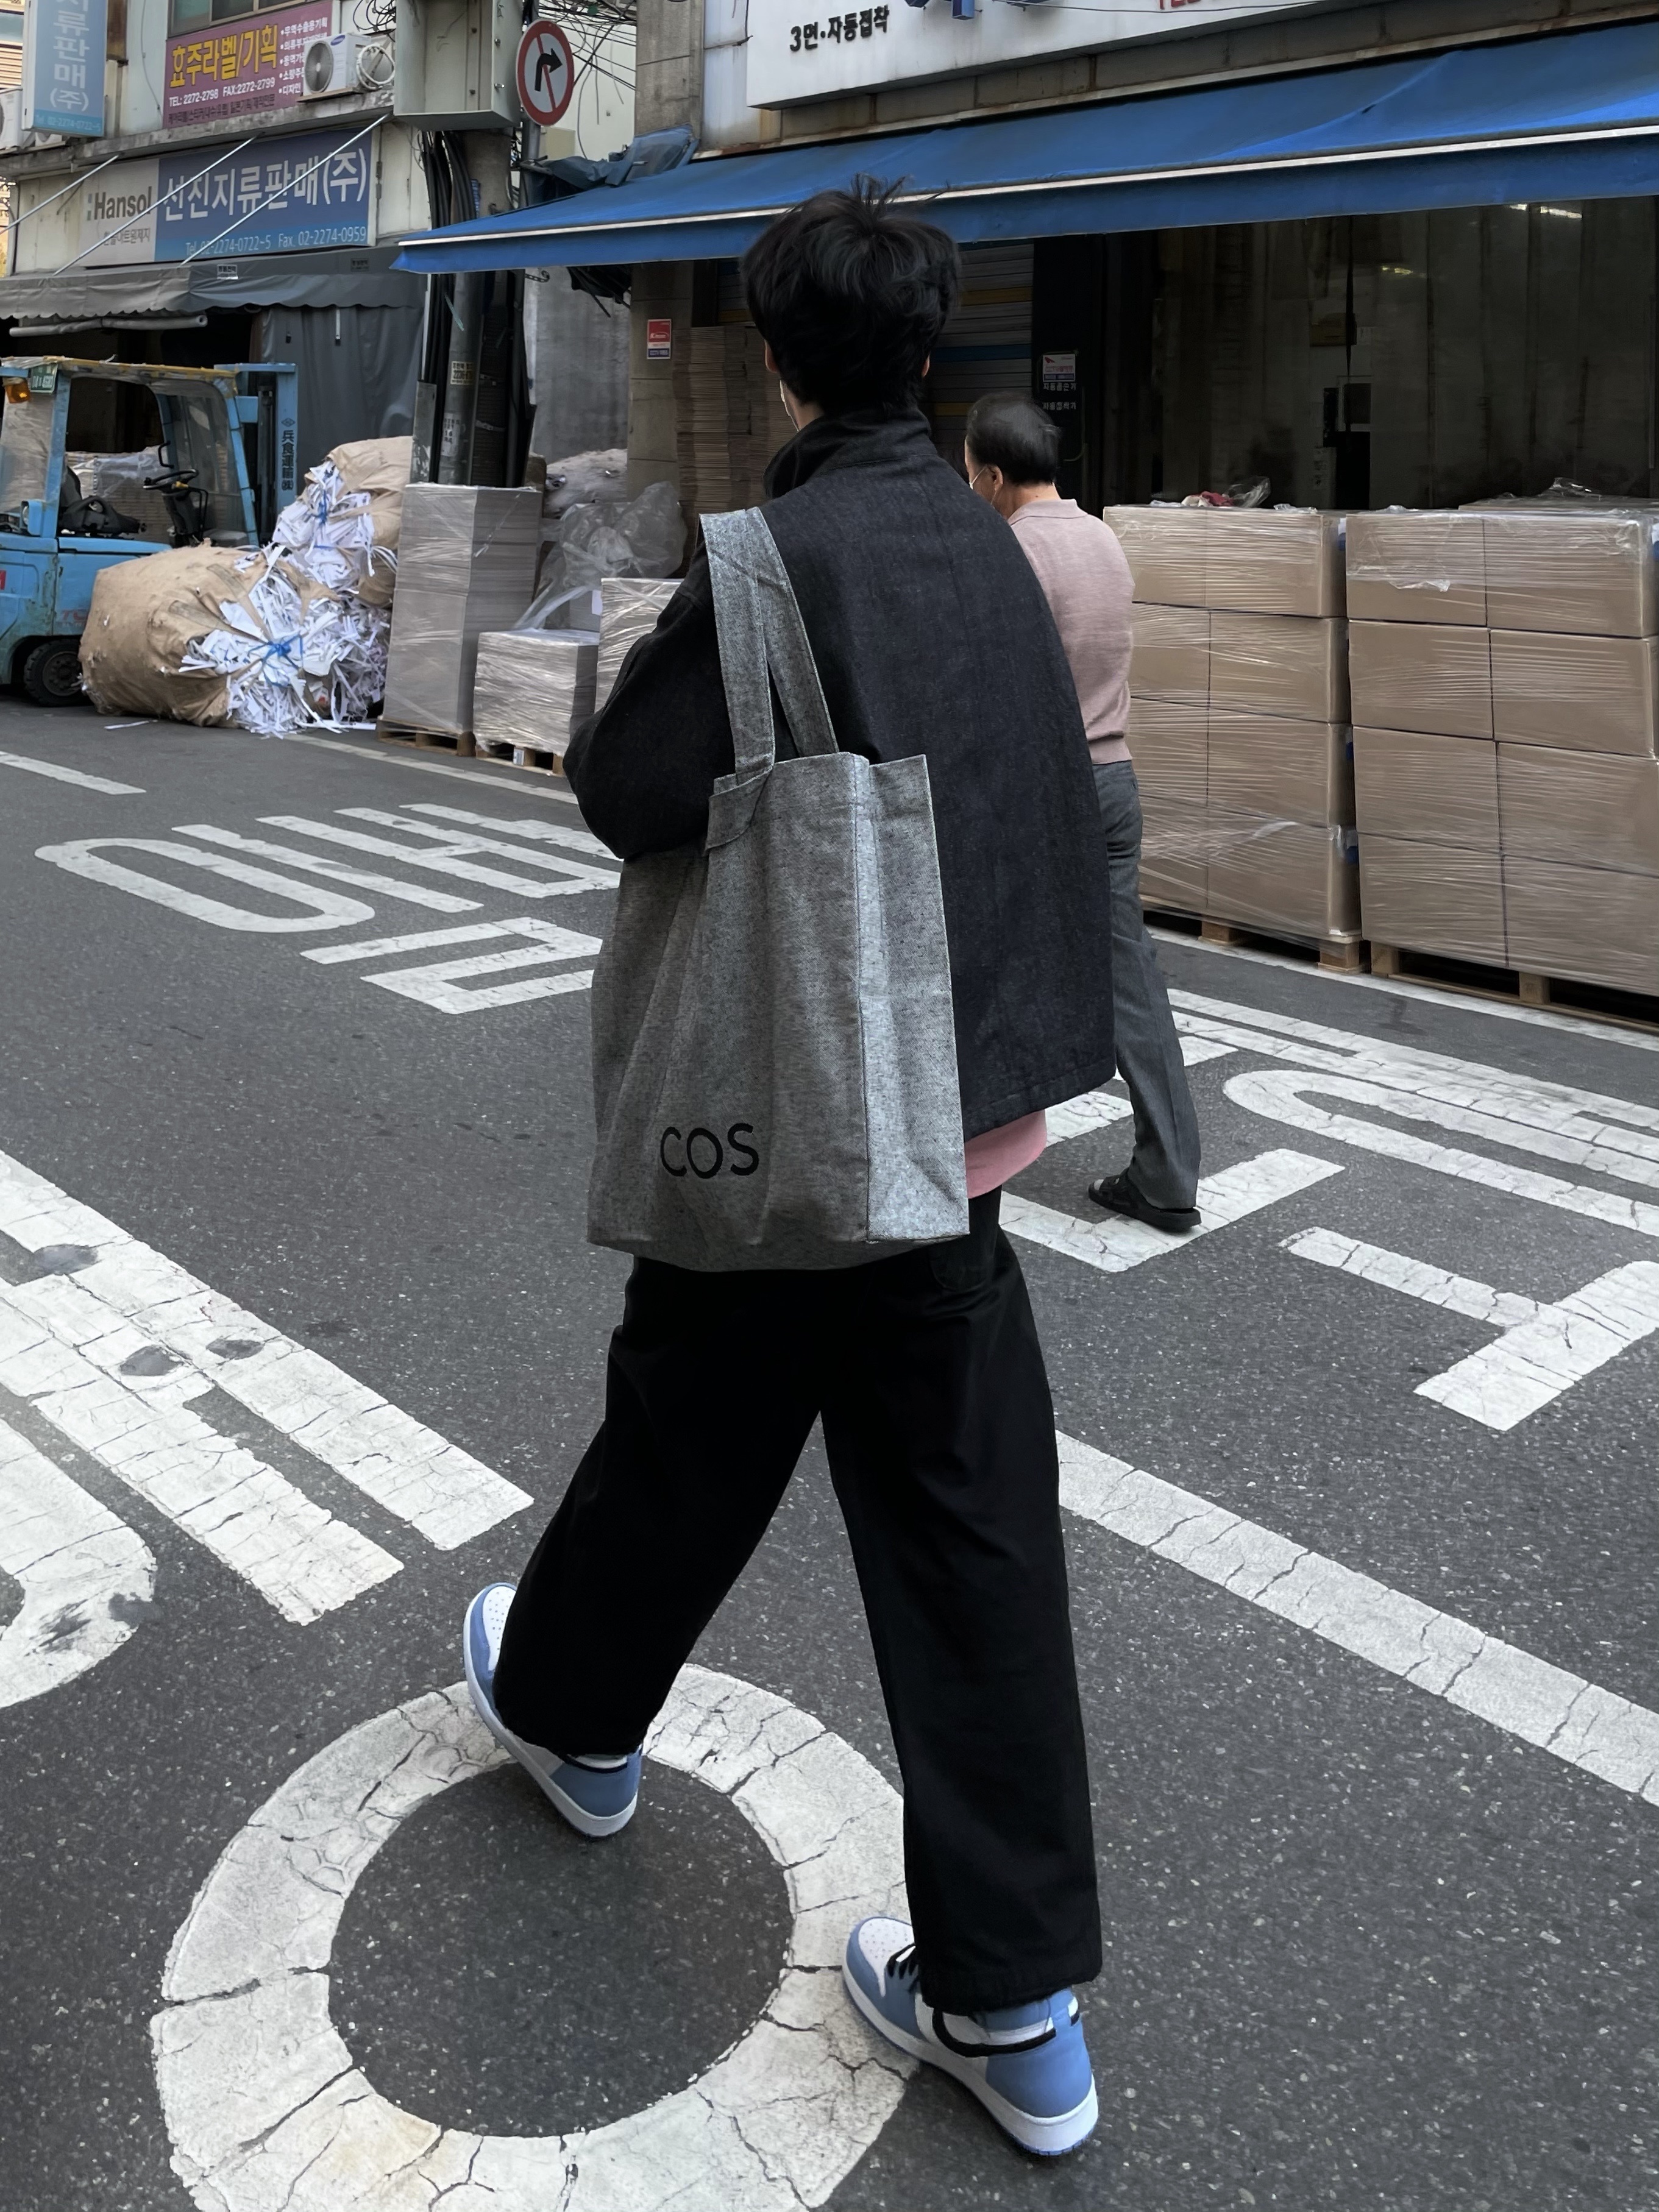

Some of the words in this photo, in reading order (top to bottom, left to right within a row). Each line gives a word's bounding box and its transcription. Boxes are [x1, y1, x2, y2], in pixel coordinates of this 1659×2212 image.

[169, 23, 279, 88] 효주라벨/기획
[169, 96, 182, 107] TEL:
[183, 88, 219, 105] 2272-2798
[282, 82, 302, 96] 디자인
[163, 147, 367, 222] 선진지류판매(주)
[94, 186, 152, 220] Hansol
[298, 226, 367, 246] 02-2274-0959
[659, 1122, 760, 1179] COS
